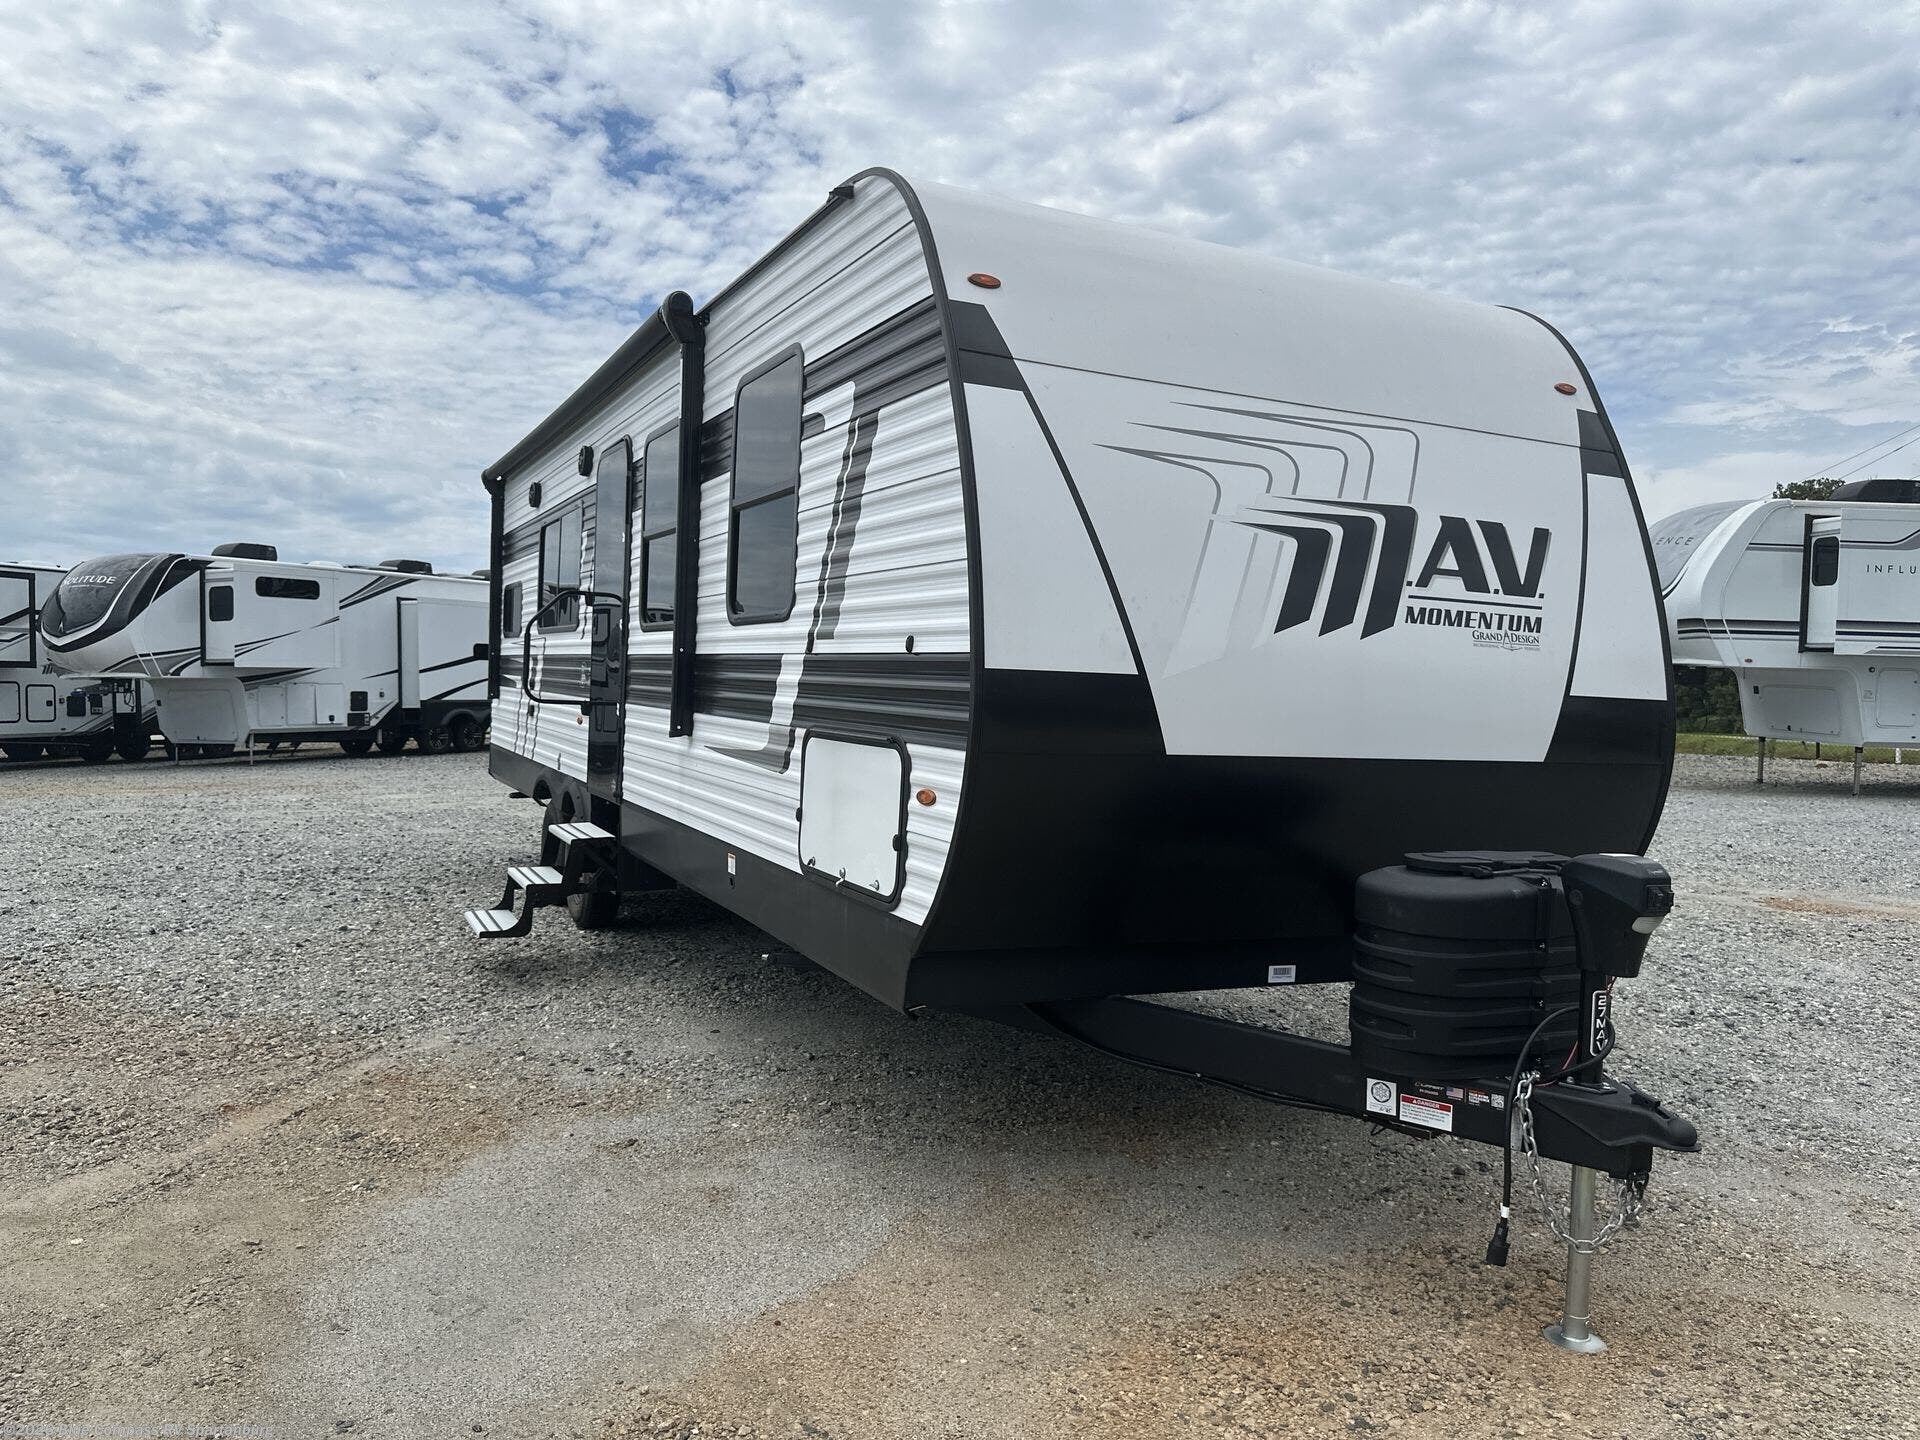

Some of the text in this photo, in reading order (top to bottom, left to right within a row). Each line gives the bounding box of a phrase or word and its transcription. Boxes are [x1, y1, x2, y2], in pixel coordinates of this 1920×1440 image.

[1405, 606, 1543, 634] MOMENTUM
[1472, 630, 1540, 644] GRAND DESIGN
